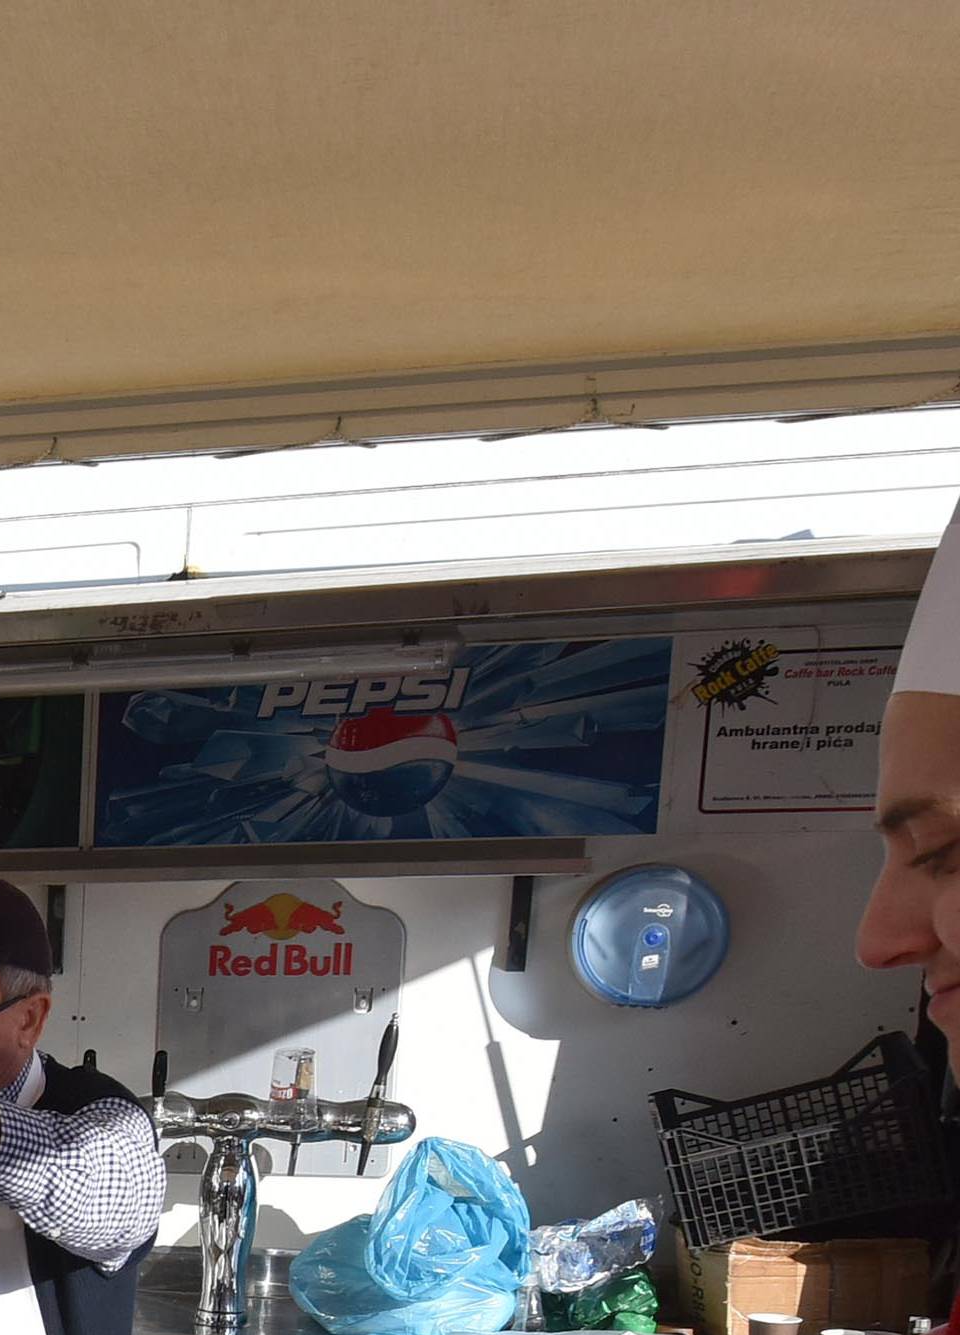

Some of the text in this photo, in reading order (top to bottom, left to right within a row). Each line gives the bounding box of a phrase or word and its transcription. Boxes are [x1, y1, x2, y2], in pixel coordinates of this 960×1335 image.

[837, 666, 865, 677] Rock
[257, 667, 470, 718] PEPSI
[716, 721, 882, 738] Ambulantna prodaj
[751, 738, 800, 750] hrane
[816, 736, 854, 751] pića
[209, 942, 353, 977] Red Bull
